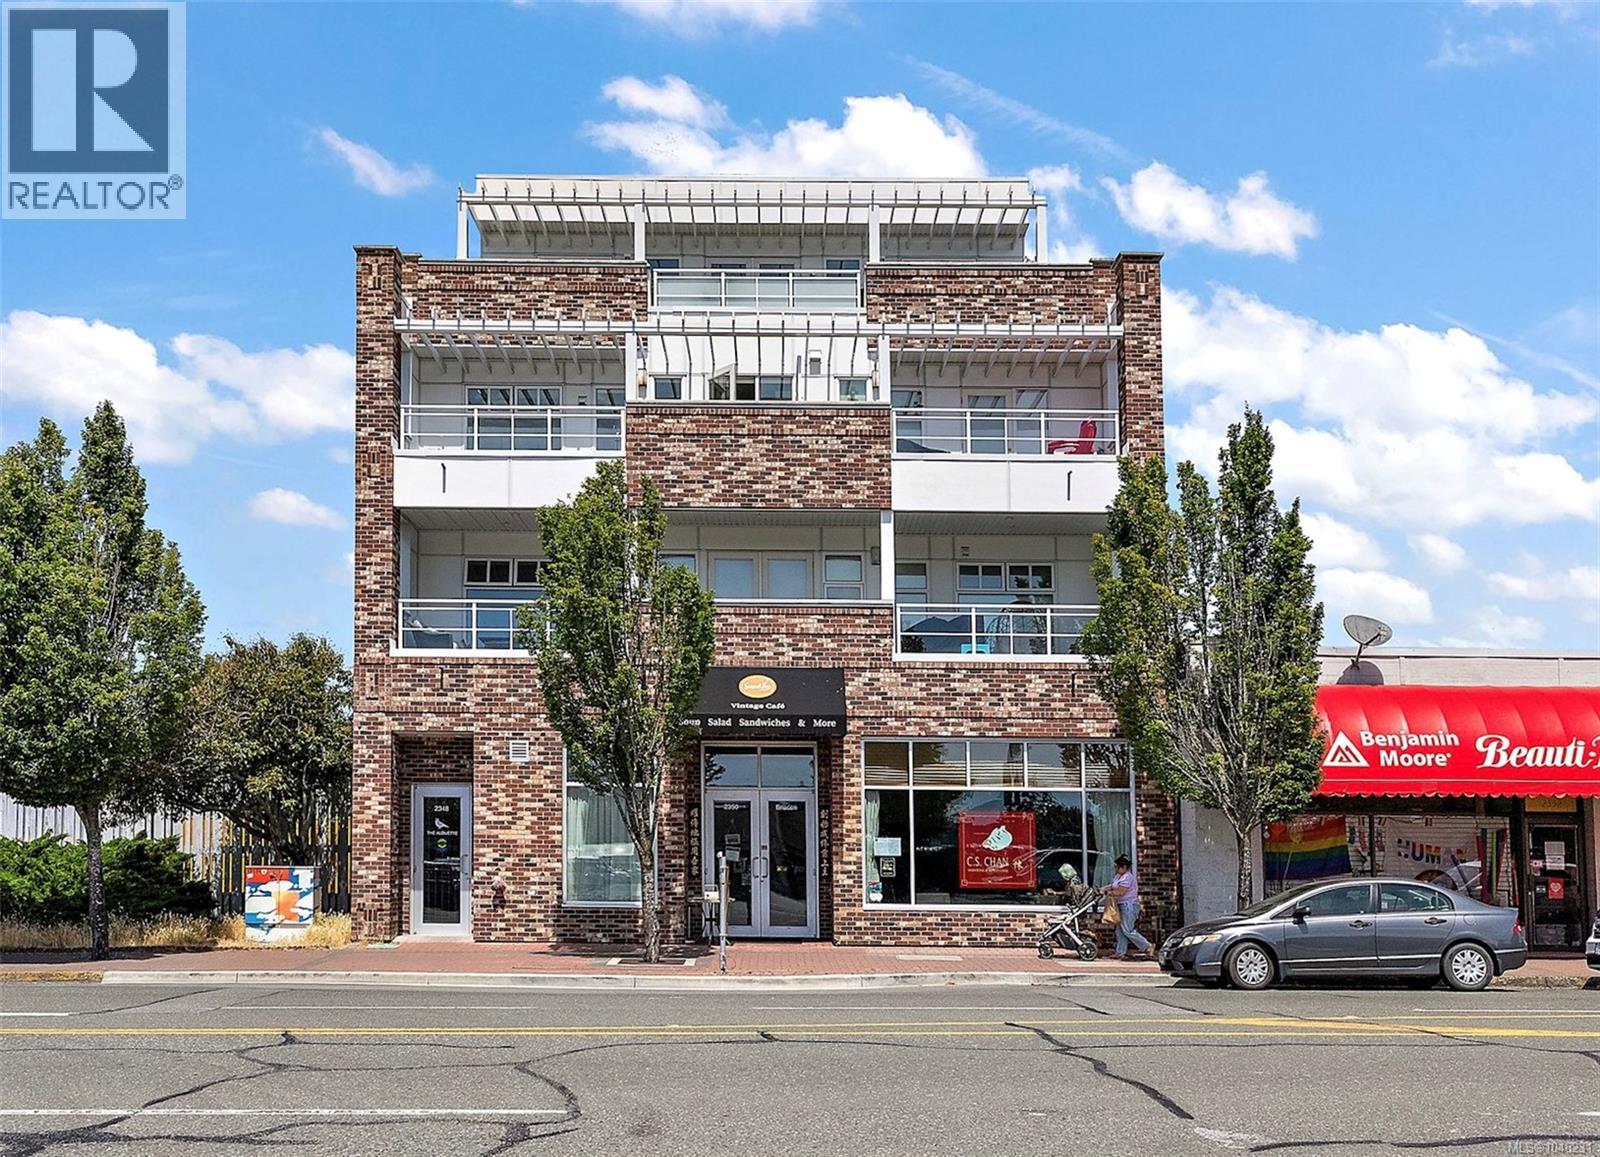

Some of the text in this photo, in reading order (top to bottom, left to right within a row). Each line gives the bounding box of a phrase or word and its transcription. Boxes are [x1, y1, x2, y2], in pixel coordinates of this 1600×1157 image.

[731, 702, 764, 710] Vintage
[708, 717, 732, 727] Salad
[739, 717, 791, 728] Sandwiches
[798, 718, 806, 727] &
[813, 718, 837, 728] More
[1360, 730, 1460, 750] Benjamin
[984, 856, 1009, 868] CHAN
